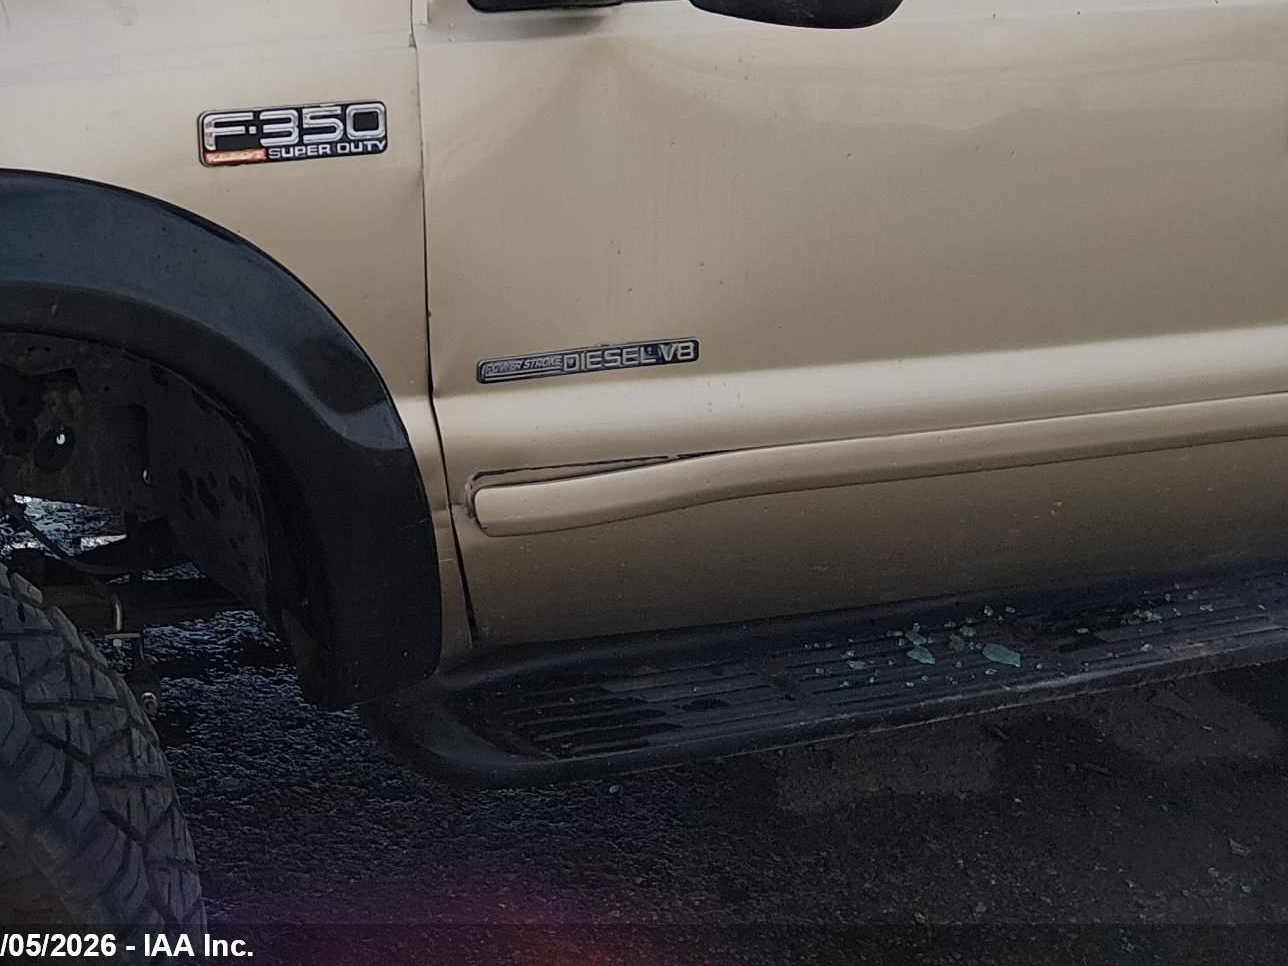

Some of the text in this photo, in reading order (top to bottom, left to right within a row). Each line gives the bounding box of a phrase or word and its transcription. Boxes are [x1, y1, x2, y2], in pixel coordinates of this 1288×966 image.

[203, 103, 386, 151] F-350
[268, 144, 331, 159] SUPER
[336, 140, 386, 154] DUTY
[522, 355, 562, 370] STROKE
[563, 346, 657, 372] DIESEL
[658, 342, 695, 362] V8
